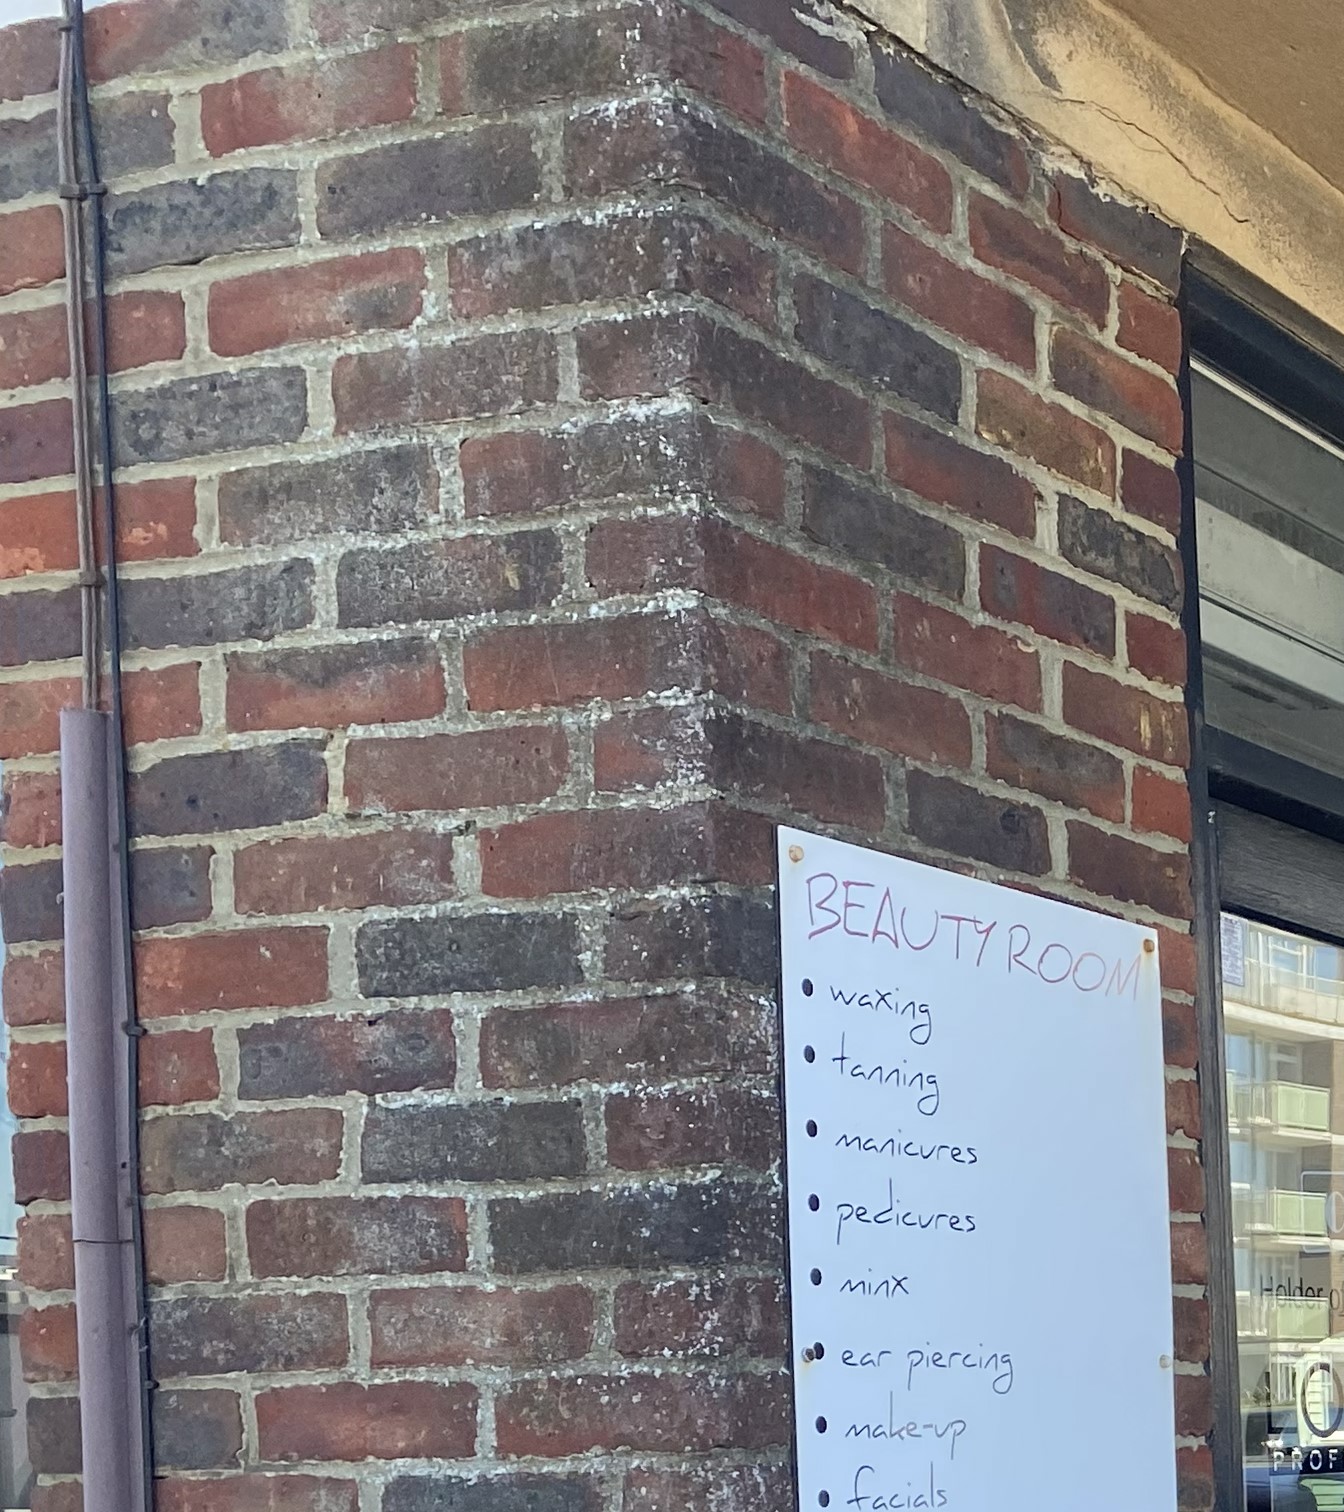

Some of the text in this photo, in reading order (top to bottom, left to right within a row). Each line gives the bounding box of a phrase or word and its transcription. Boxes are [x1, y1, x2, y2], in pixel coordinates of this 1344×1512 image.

[806, 872, 1142, 1002] BEAUTY ROOM
[829, 981, 932, 1045] waxing
[831, 1031, 940, 1115] tanning
[835, 1128, 979, 1165] manicures
[836, 1178, 977, 1245] pedicures
[840, 1269, 910, 1298] minx
[1260, 1274, 1324, 1311] Holder
[841, 1342, 1014, 1394] ear piercing
[845, 1391, 966, 1460] make-up
[846, 1461, 948, 1511] facials
